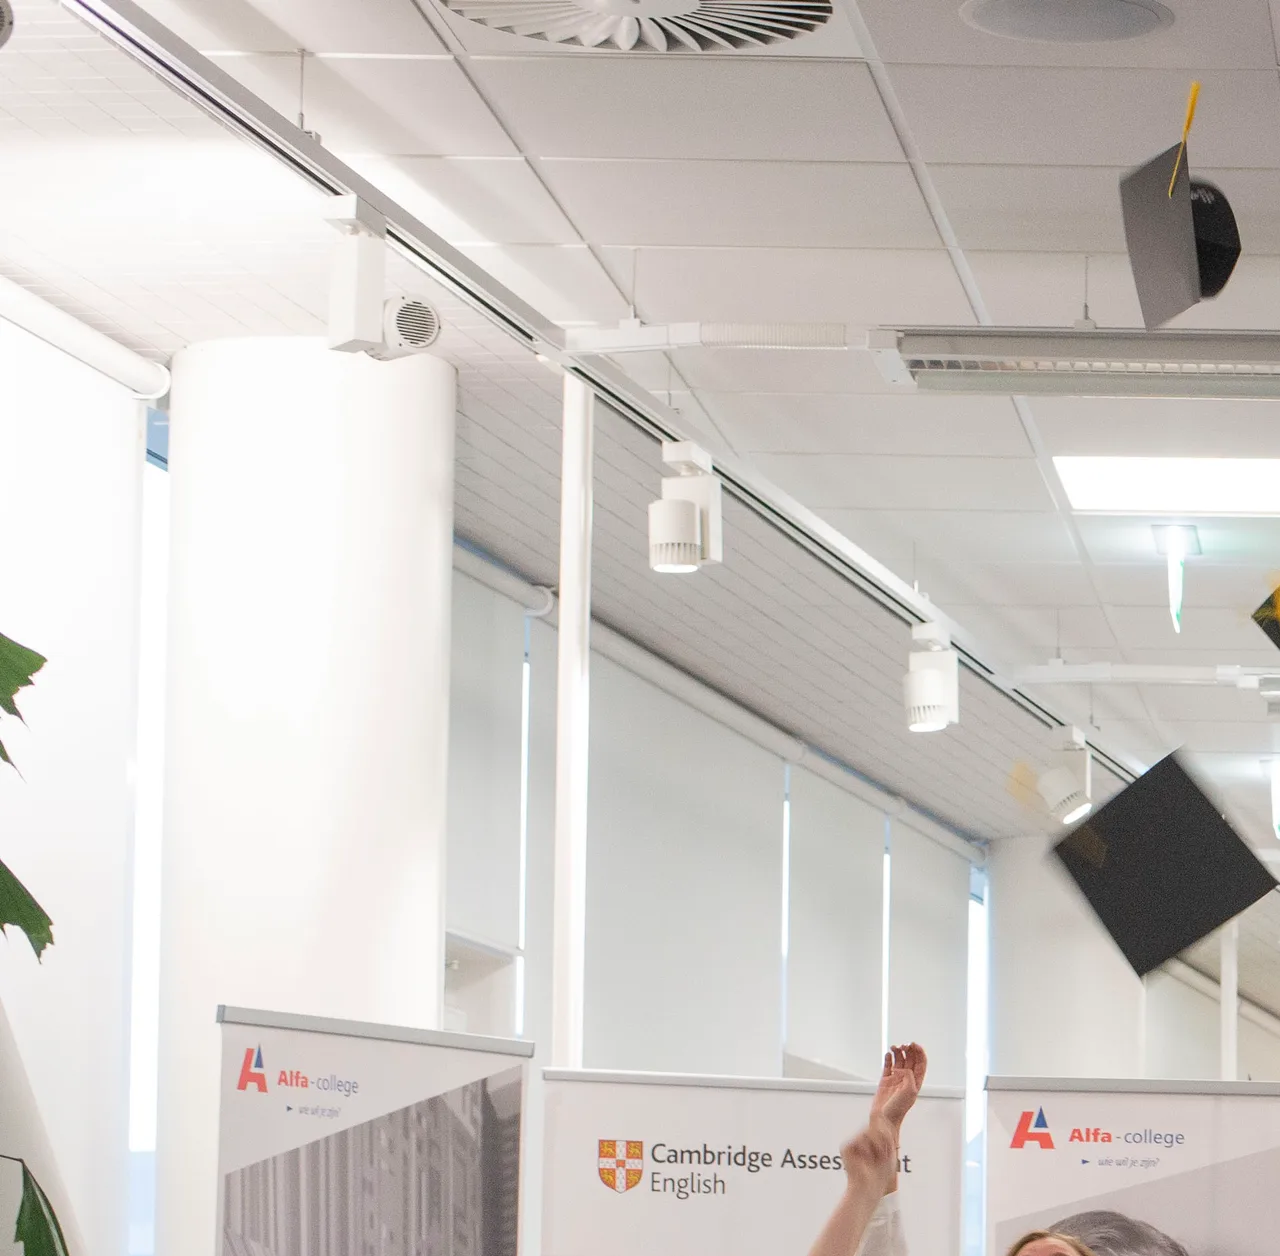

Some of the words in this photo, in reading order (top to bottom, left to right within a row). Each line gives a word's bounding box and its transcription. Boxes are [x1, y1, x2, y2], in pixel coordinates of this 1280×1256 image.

[651, 1143, 773, 1173] Cambridge
[780, 1148, 912, 1174] Assest
[651, 1172, 726, 1199] English
